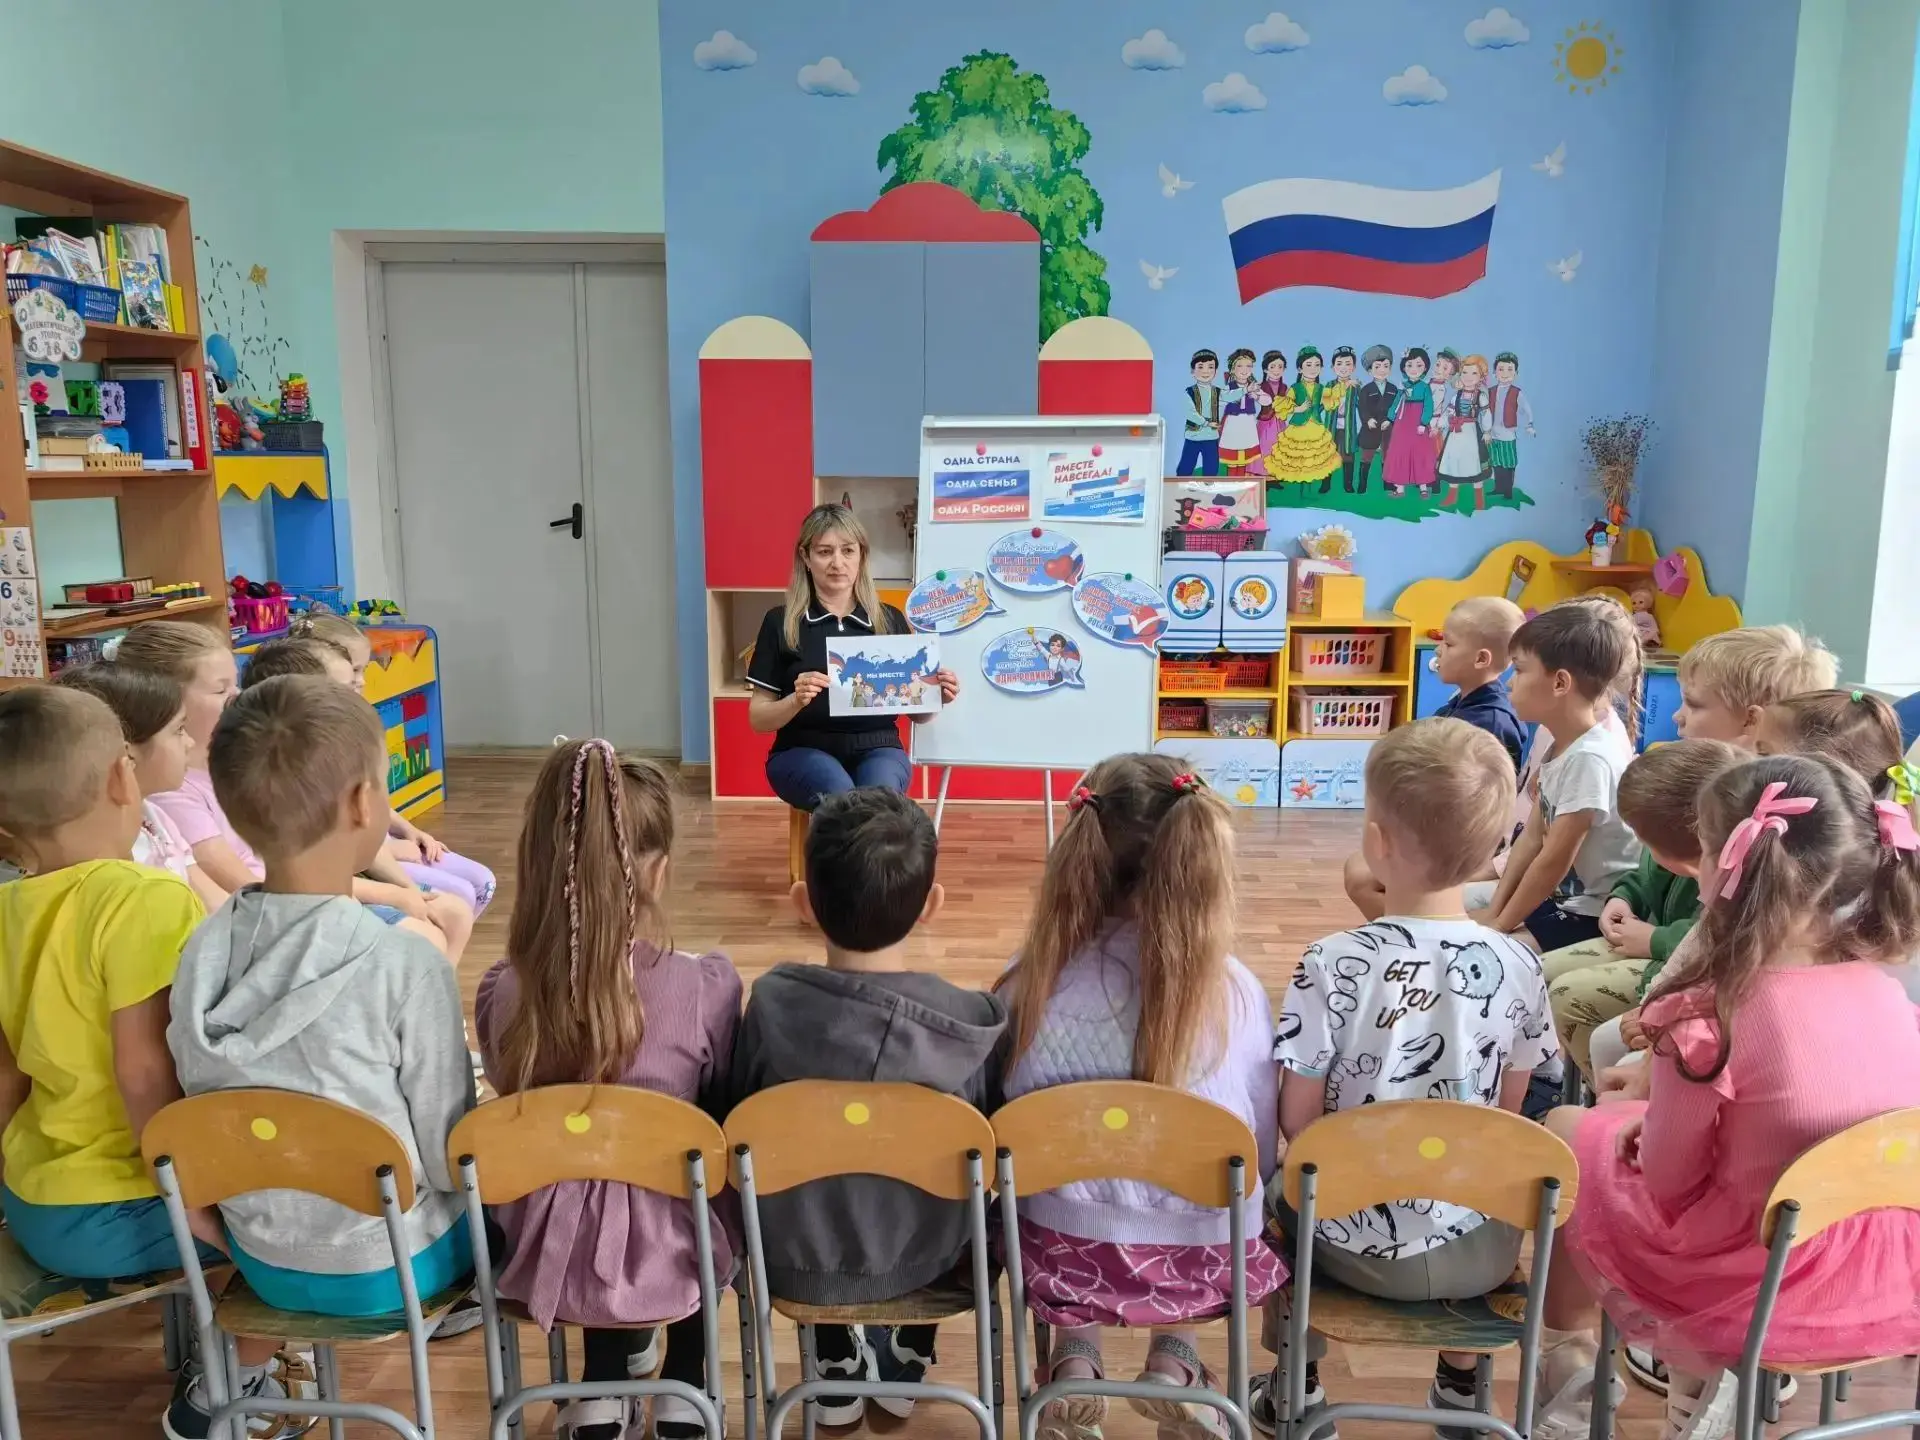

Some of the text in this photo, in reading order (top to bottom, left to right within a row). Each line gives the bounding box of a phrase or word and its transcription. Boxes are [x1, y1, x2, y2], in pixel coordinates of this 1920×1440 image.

[943, 456, 1021, 466] ОДНА СТРАНА
[1054, 460, 1094, 474] ВМЕСТЕ
[946, 478, 1017, 489] ОДНА СЕМЬЯ
[1054, 467, 1112, 483] НАВСЕГДА!
[938, 506, 969, 515] ОДНА
[1, 581, 13, 599] 6
[4, 629, 16, 647] 9
[1383, 959, 1431, 983] GET
[1398, 984, 1442, 1012] YOU
[1375, 1007, 1407, 1029] UP
